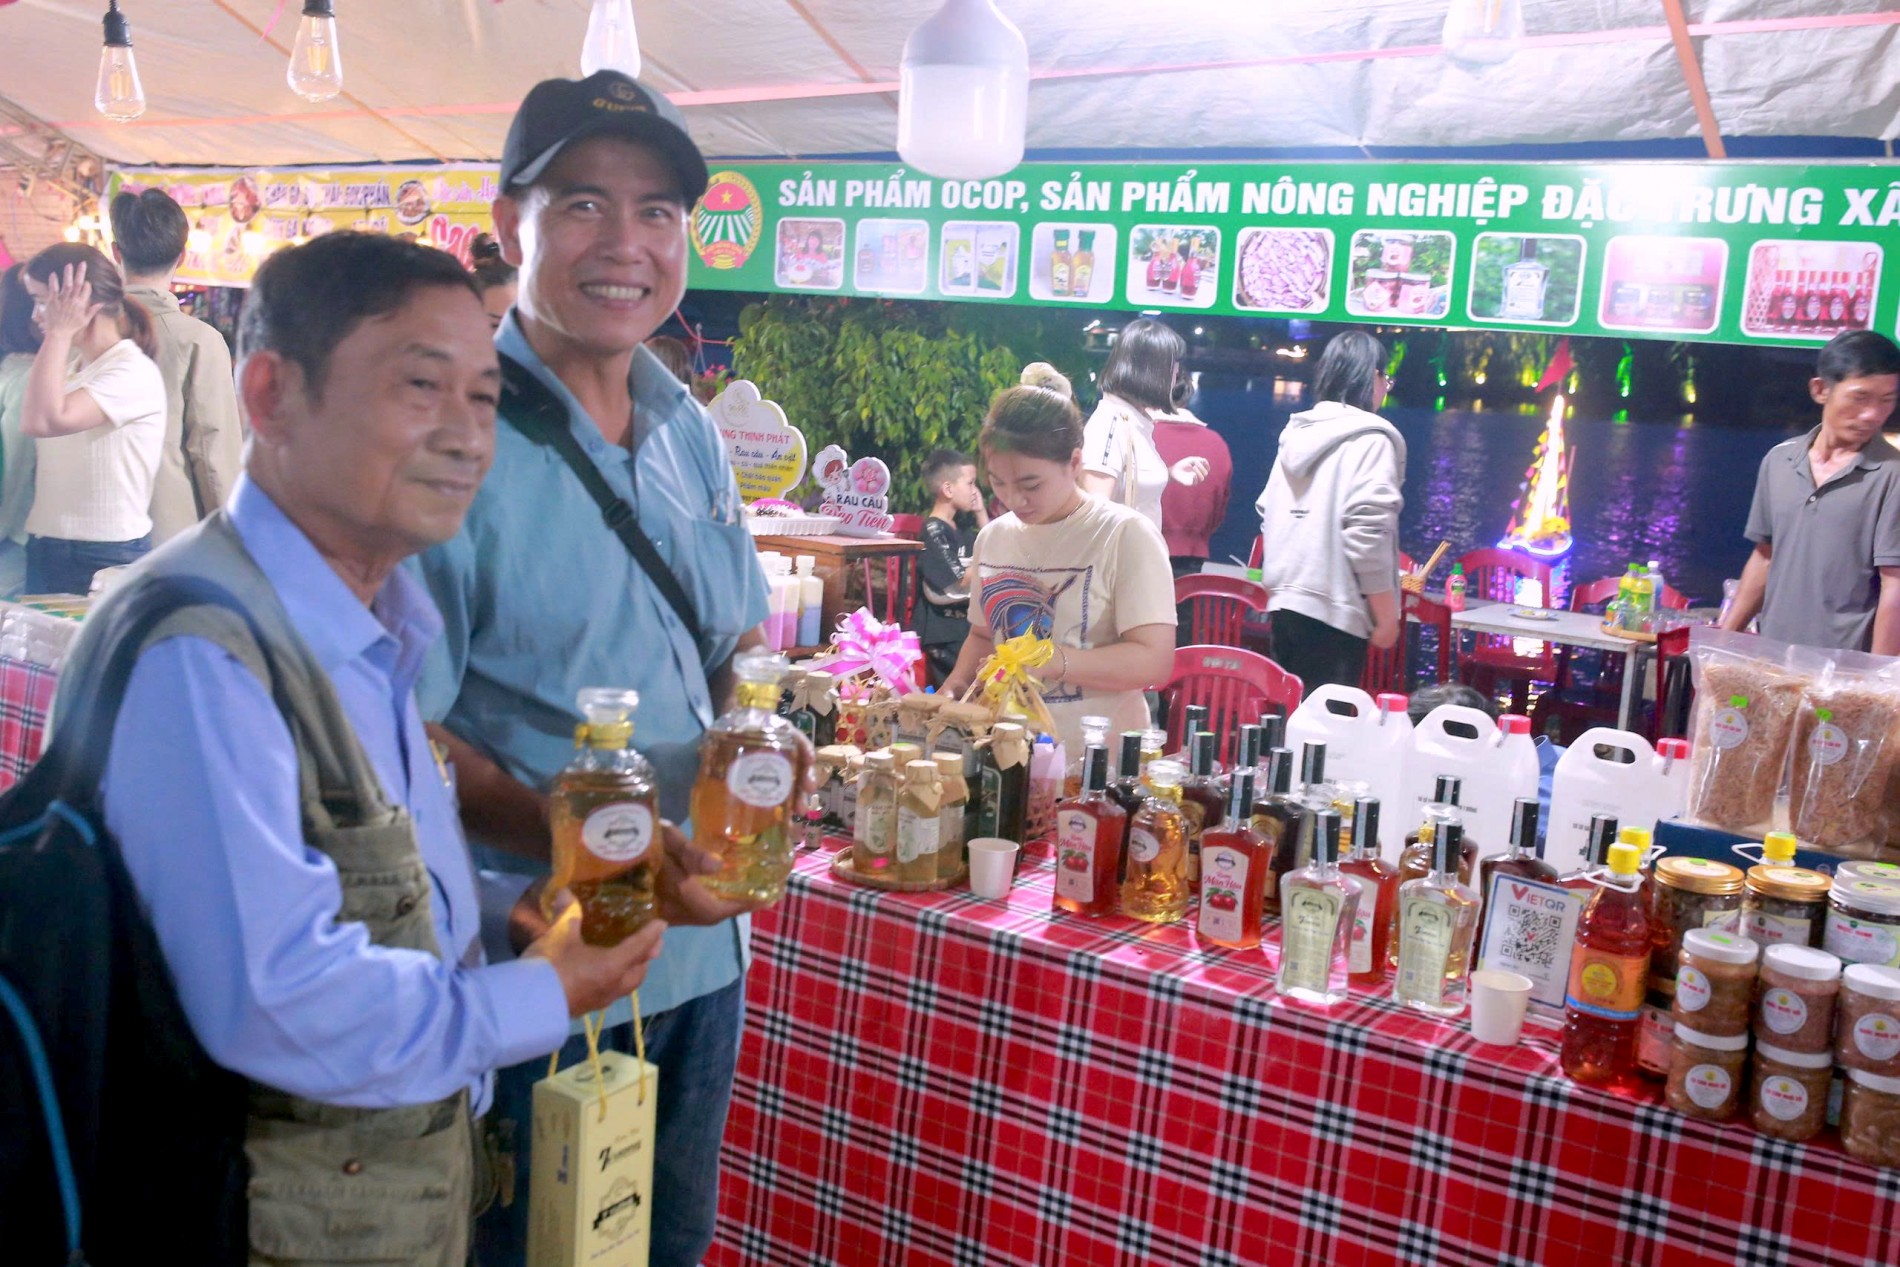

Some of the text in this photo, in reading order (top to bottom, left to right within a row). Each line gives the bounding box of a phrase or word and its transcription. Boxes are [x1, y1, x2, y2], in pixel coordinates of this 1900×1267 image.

[779, 171, 837, 207] SẢN
[845, 169, 932, 208] PHẨM
[941, 180, 1029, 213] OCOP,
[1040, 171, 1111, 212] SẢN
[1121, 169, 1230, 213] PHẨM
[1241, 175, 1355, 215] NÔNG
[1366, 176, 1529, 226] NGHIỆP
[836, 494, 883, 509] RAU CÂU
[1511, 883, 1566, 912] VIETQR
